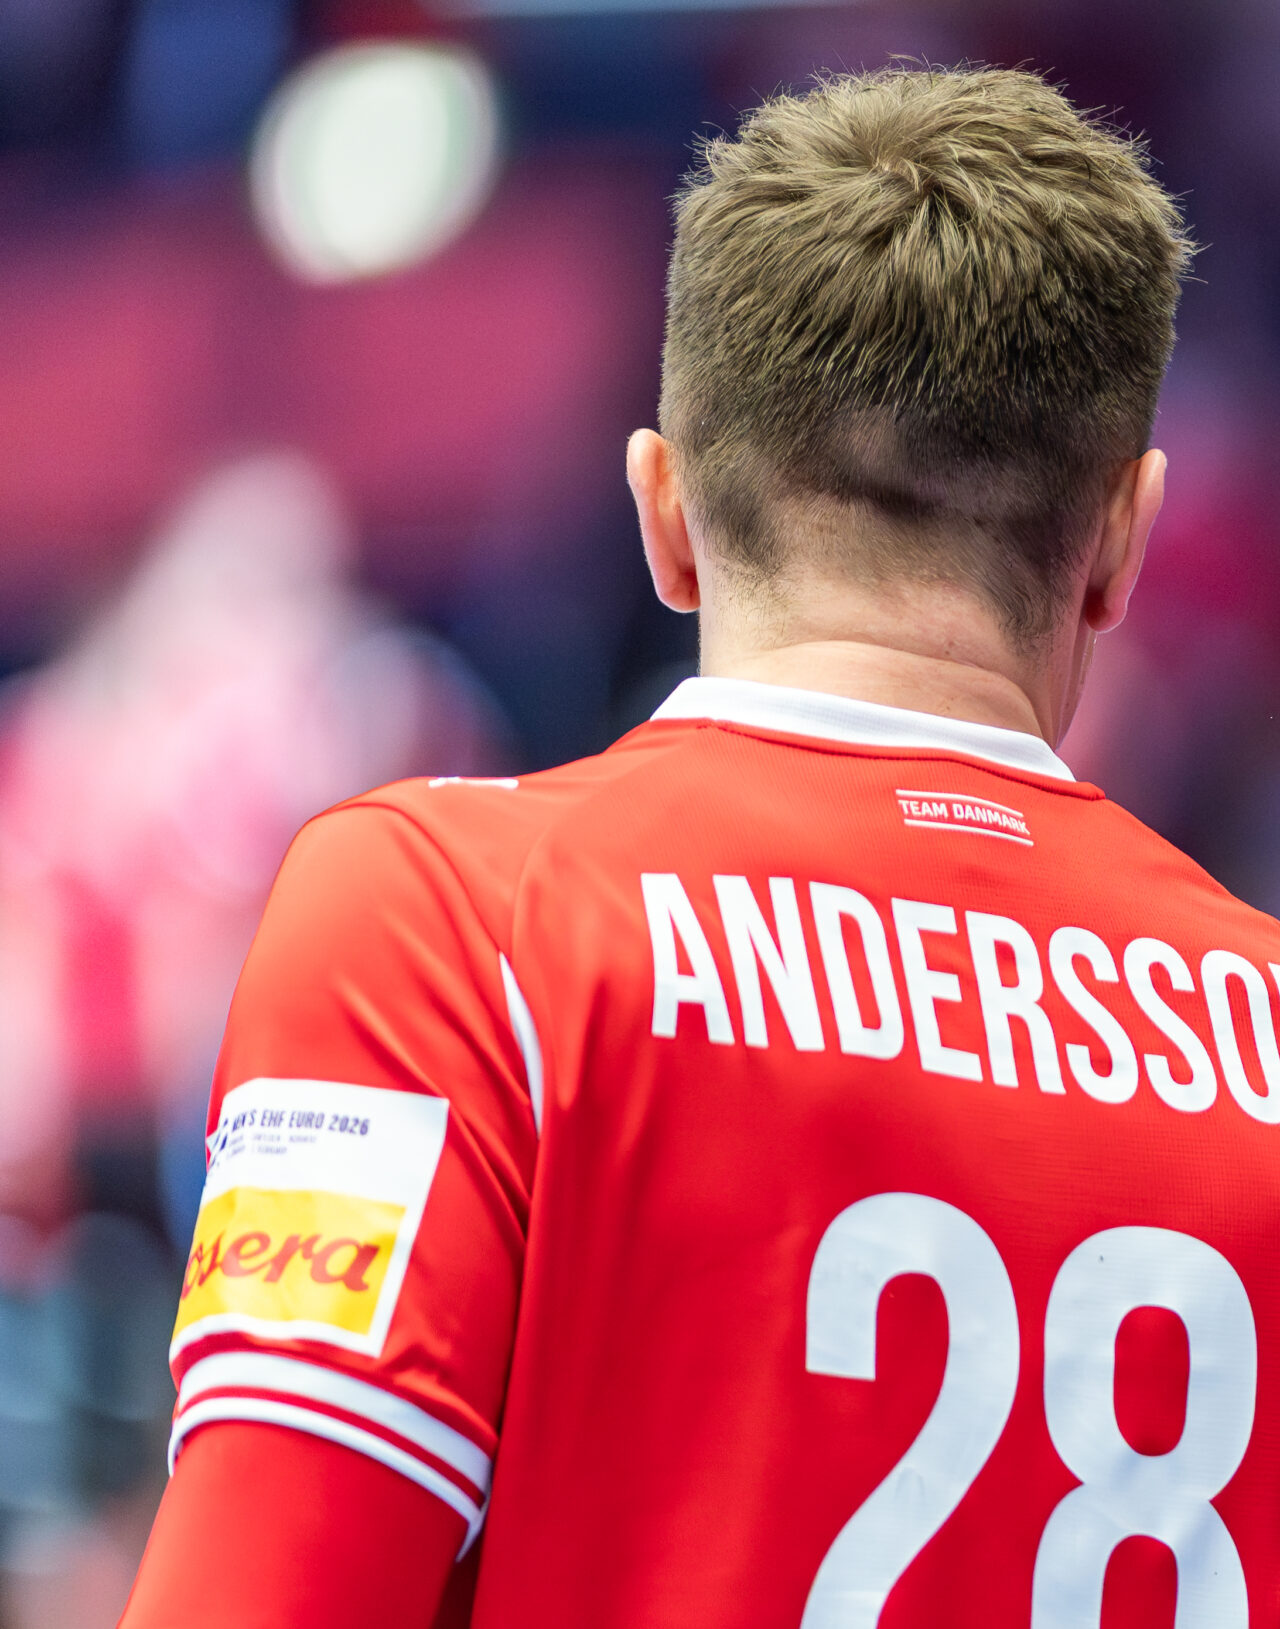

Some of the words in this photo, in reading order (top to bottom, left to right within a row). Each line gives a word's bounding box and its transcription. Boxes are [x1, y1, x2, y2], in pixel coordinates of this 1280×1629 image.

[898, 799, 948, 818] TEAM
[952, 803, 1031, 836] DANMARK
[260, 1109, 285, 1128] EHF
[288, 1110, 325, 1129] EURO
[328, 1114, 370, 1136] 2026
[181, 1227, 381, 1300] osera
[800, 1191, 1258, 1629] 28
